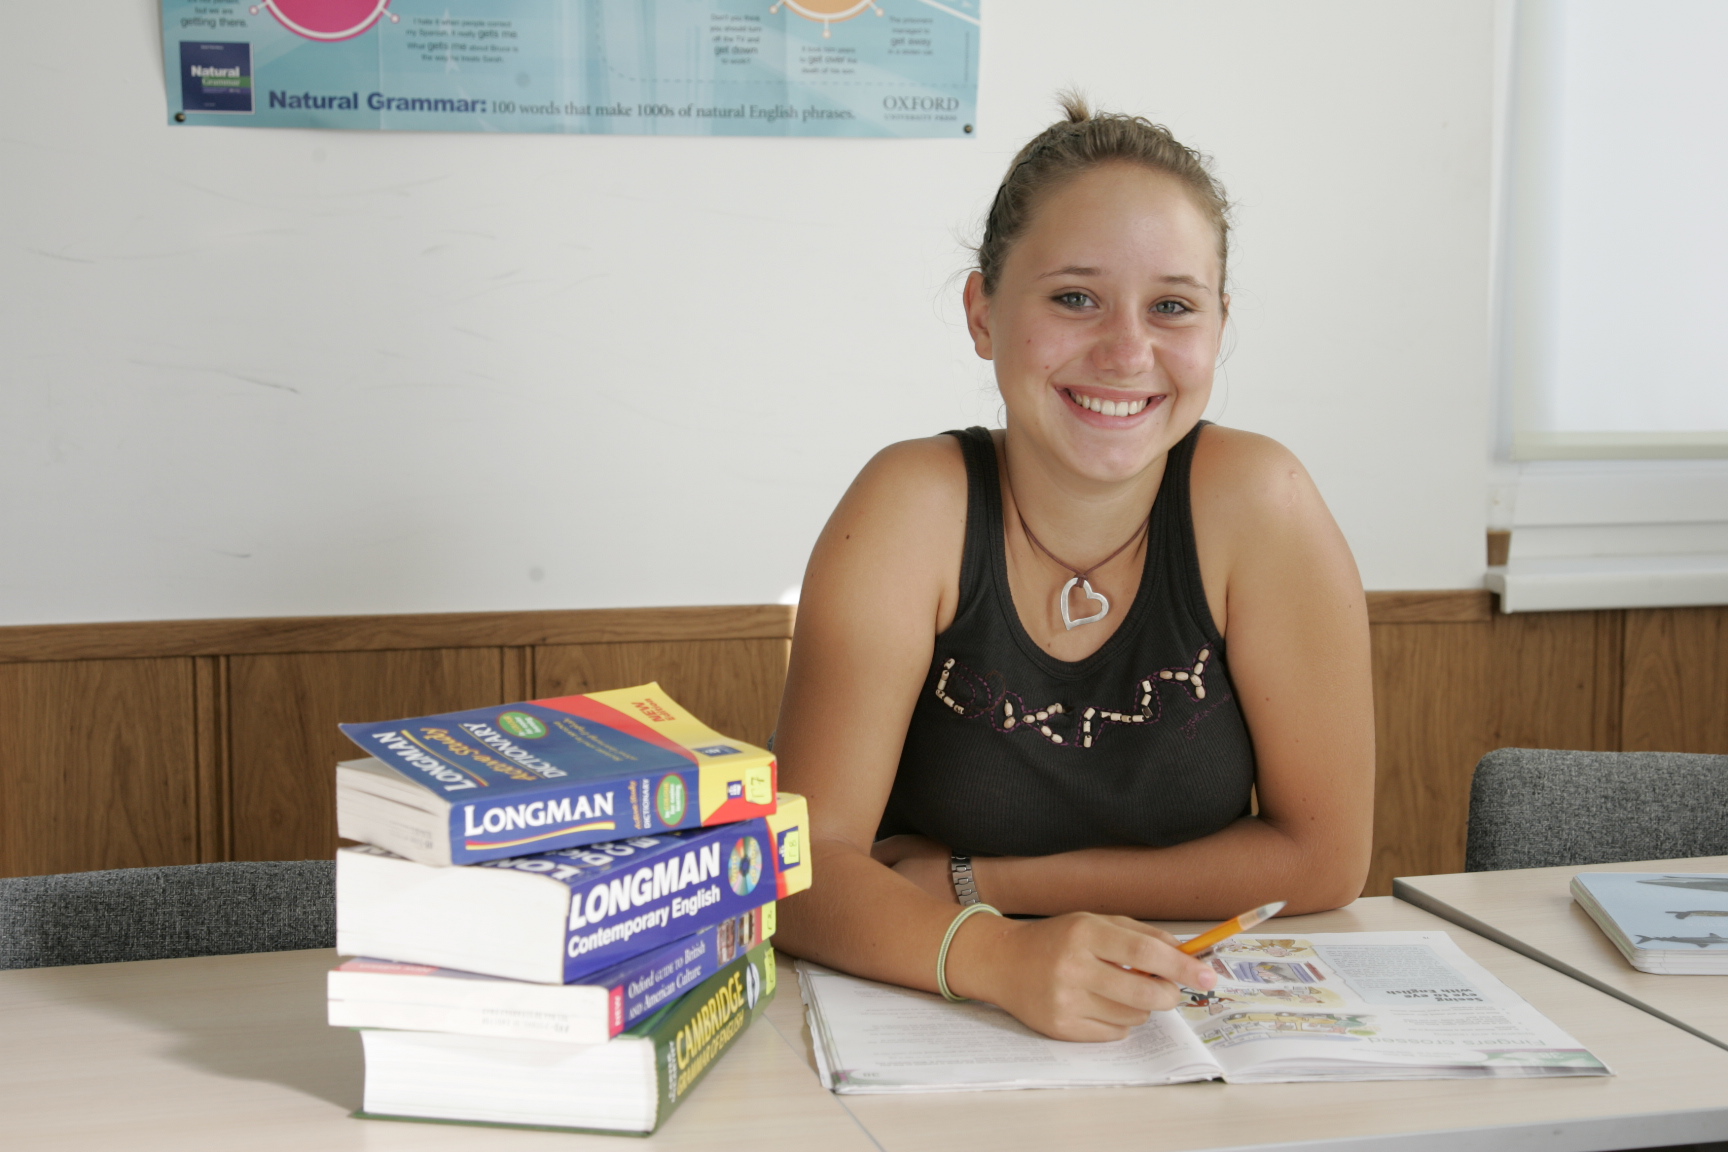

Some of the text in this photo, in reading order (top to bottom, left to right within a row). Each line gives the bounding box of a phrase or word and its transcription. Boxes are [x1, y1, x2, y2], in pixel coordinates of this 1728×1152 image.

[181, 17, 247, 28] getting there.
[478, 29, 499, 40] gets
[427, 42, 448, 51] gets
[451, 42, 467, 50] me
[714, 46, 758, 56] get down
[891, 38, 931, 48] get away
[191, 65, 240, 77] Natural
[808, 55, 823, 65] get
[202, 78, 240, 87] Grammar
[268, 91, 855, 122] Natural Grammar: 100 words that make 1000s of natural English phrases.
[883, 95, 959, 111] OXFORD
[631, 702, 665, 722] NEW
[644, 698, 676, 721] Edition
[371, 731, 478, 791] LONGMAN
[419, 727, 538, 781] Active Study
[463, 722, 568, 779] DICTIONARY
[464, 791, 614, 837] LONGMAN
[628, 780, 643, 830] Active Study
[642, 778, 652, 829] DICTIONARY
[569, 841, 720, 931] LONGMAN
[568, 884, 720, 957] Contemporary English
[628, 940, 706, 999] Oxford GUIDE TO British
[628, 965, 702, 1020] AND American Culture
[614, 995, 622, 1026] NEW
[676, 970, 744, 1070] CAMBRIDGE
[677, 1009, 744, 1097] GRAMMAR OF ENGLISH
[1368, 1037, 1454, 1045] crossed
